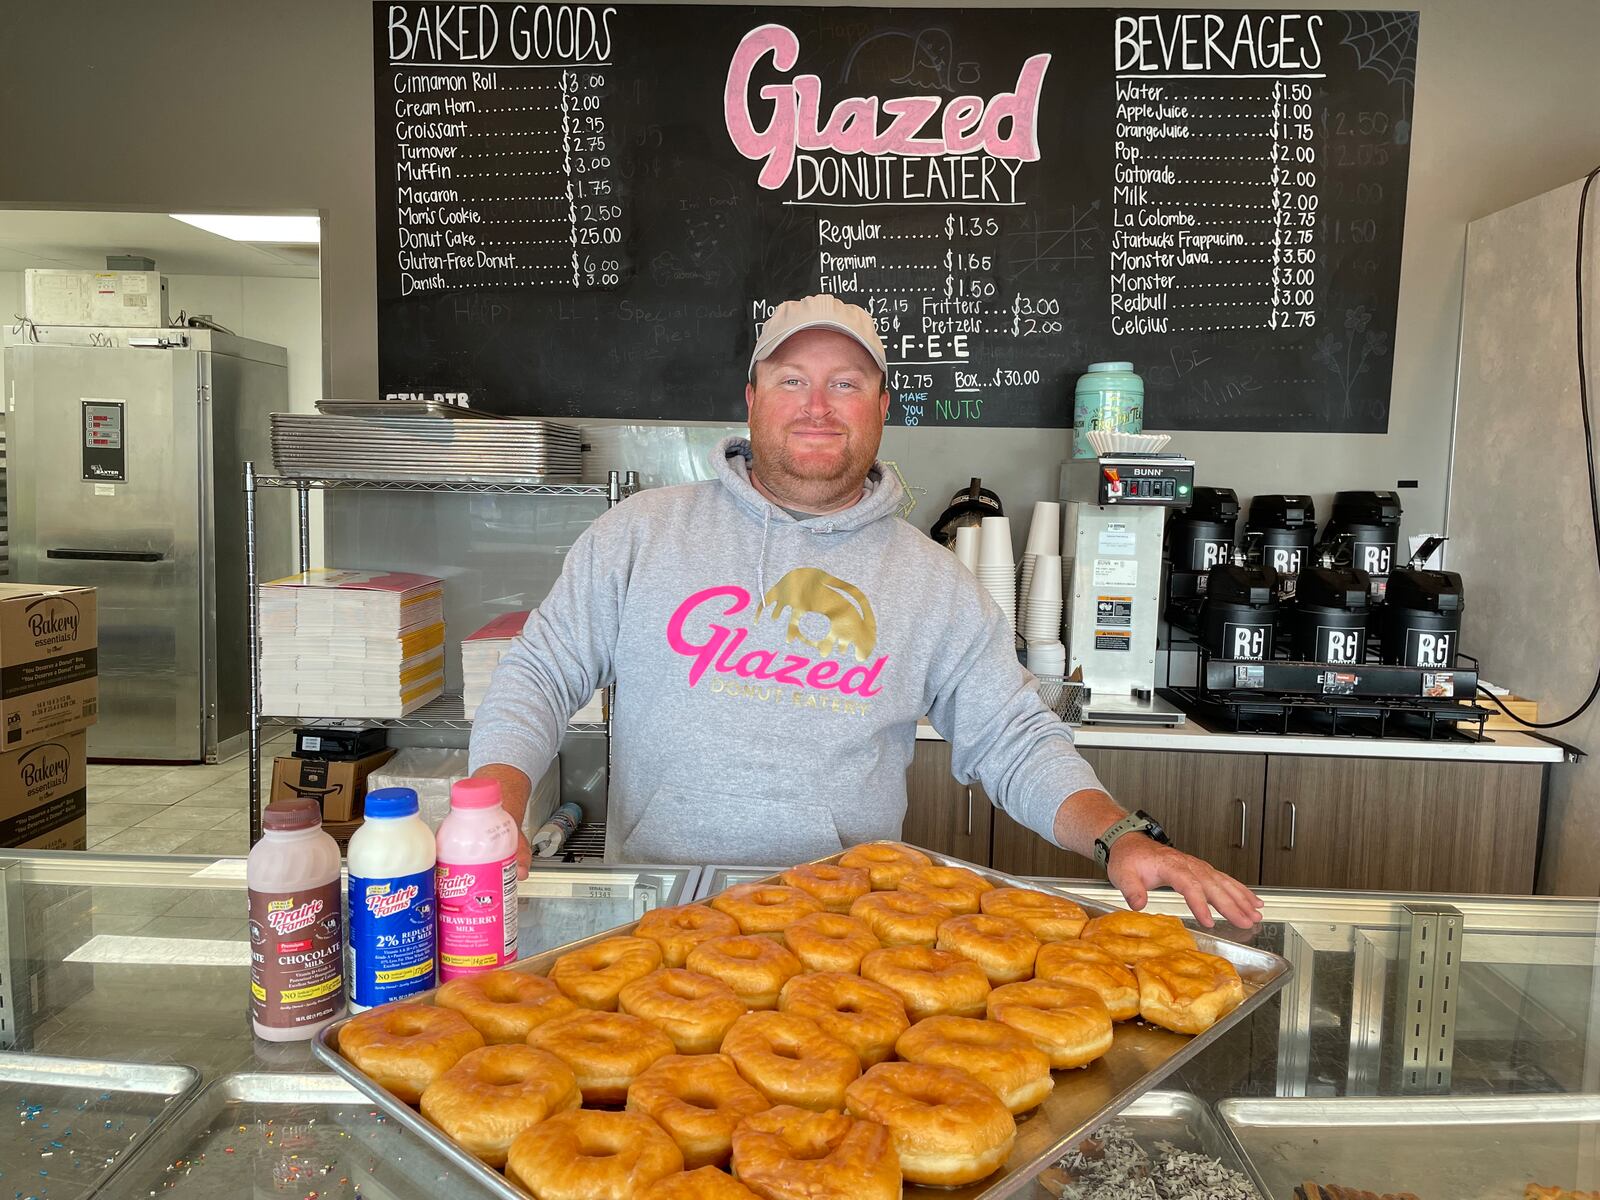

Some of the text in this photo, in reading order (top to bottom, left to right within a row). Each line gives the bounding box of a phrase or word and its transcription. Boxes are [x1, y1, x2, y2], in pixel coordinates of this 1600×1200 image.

[388, 4, 617, 61] BAKED GOODS
[1115, 14, 1323, 71] BEVERAGES
[394, 69, 605, 94] Cinnamon Roll $3.00
[1116, 80, 1312, 102] Water $1.50
[395, 94, 600, 117] Cream Horn $2.00
[724, 23, 1052, 190] Glazed
[1271, 103, 1312, 120] $1.00
[396, 116, 604, 140] Croissant $2.95
[1269, 122, 1313, 141] $1.75
[398, 137, 605, 160] Turnover $2.75
[1115, 142, 1139, 161] Pop
[1270, 144, 1315, 164] $2.00
[397, 156, 611, 181] Muffin $3.00
[797, 156, 1024, 203] DONUT EATERY
[1115, 165, 1316, 187] Gatorade $2.00
[399, 180, 611, 204] Macaron $1.75
[1113, 185, 1319, 211] Milk $2.00
[399, 201, 621, 225] Mom's Cookie $2.50
[1113, 207, 1315, 227] La Colombe $2.75
[399, 226, 621, 249] Donut Cake $25.00
[819, 212, 999, 250] Regular $1.35
[1178, 231, 1244, 253] Frappucino
[1272, 227, 1313, 246] $2.75
[398, 250, 619, 273] Gluten-Free Donut $6.00
[819, 248, 992, 273] Premium $1.65
[1110, 250, 1175, 271] Monster
[1177, 252, 1209, 267] Java
[1272, 248, 1316, 266] $3.50
[401, 271, 619, 296] Danish $3.00
[820, 274, 995, 299] Filled $1.50
[1110, 266, 1315, 293] Monster $3.00
[868, 296, 908, 316] $2.15
[923, 292, 1059, 315] Fritters $3.00
[1111, 286, 1314, 315] Redbull $3.00
[923, 315, 1062, 337] Pretzels $2.00
[1111, 310, 1316, 336] Celcius $2.75
[890, 371, 933, 390] $2.75
[993, 369, 1040, 388] $30.00
[900, 392, 928, 402] MAKE
[903, 404, 924, 417] YOU
[905, 416, 920, 427] GO
[935, 399, 983, 421] NUTS
[1134, 468, 1160, 476] BUNN
[1203, 542, 1228, 570] RG
[1274, 549, 1300, 574] RG
[1364, 546, 1390, 574] RG
[28, 608, 78, 640] Bakery
[35, 633, 71, 647] essentials
[666, 586, 889, 697] Glazed
[1234, 628, 1264, 657] RG
[1327, 631, 1357, 661] RG
[1418, 634, 1449, 664] RG
[710, 678, 871, 716] DONUT EATERY
[21, 755, 68, 787] Bakery
[365, 885, 418, 911] Prairie
[440, 887, 468, 898] Farms
[268, 899, 323, 928] Prairie
[373, 899, 411, 918] Farms
[276, 915, 316, 935] Farms
[402, 924, 433, 938] REDUCED
[376, 934, 399, 948] 2%
[402, 936, 414, 945] FAT
[278, 942, 341, 965] CHOCOLATE
[304, 959, 324, 968] MILK
[284, 991, 296, 1000] NO
